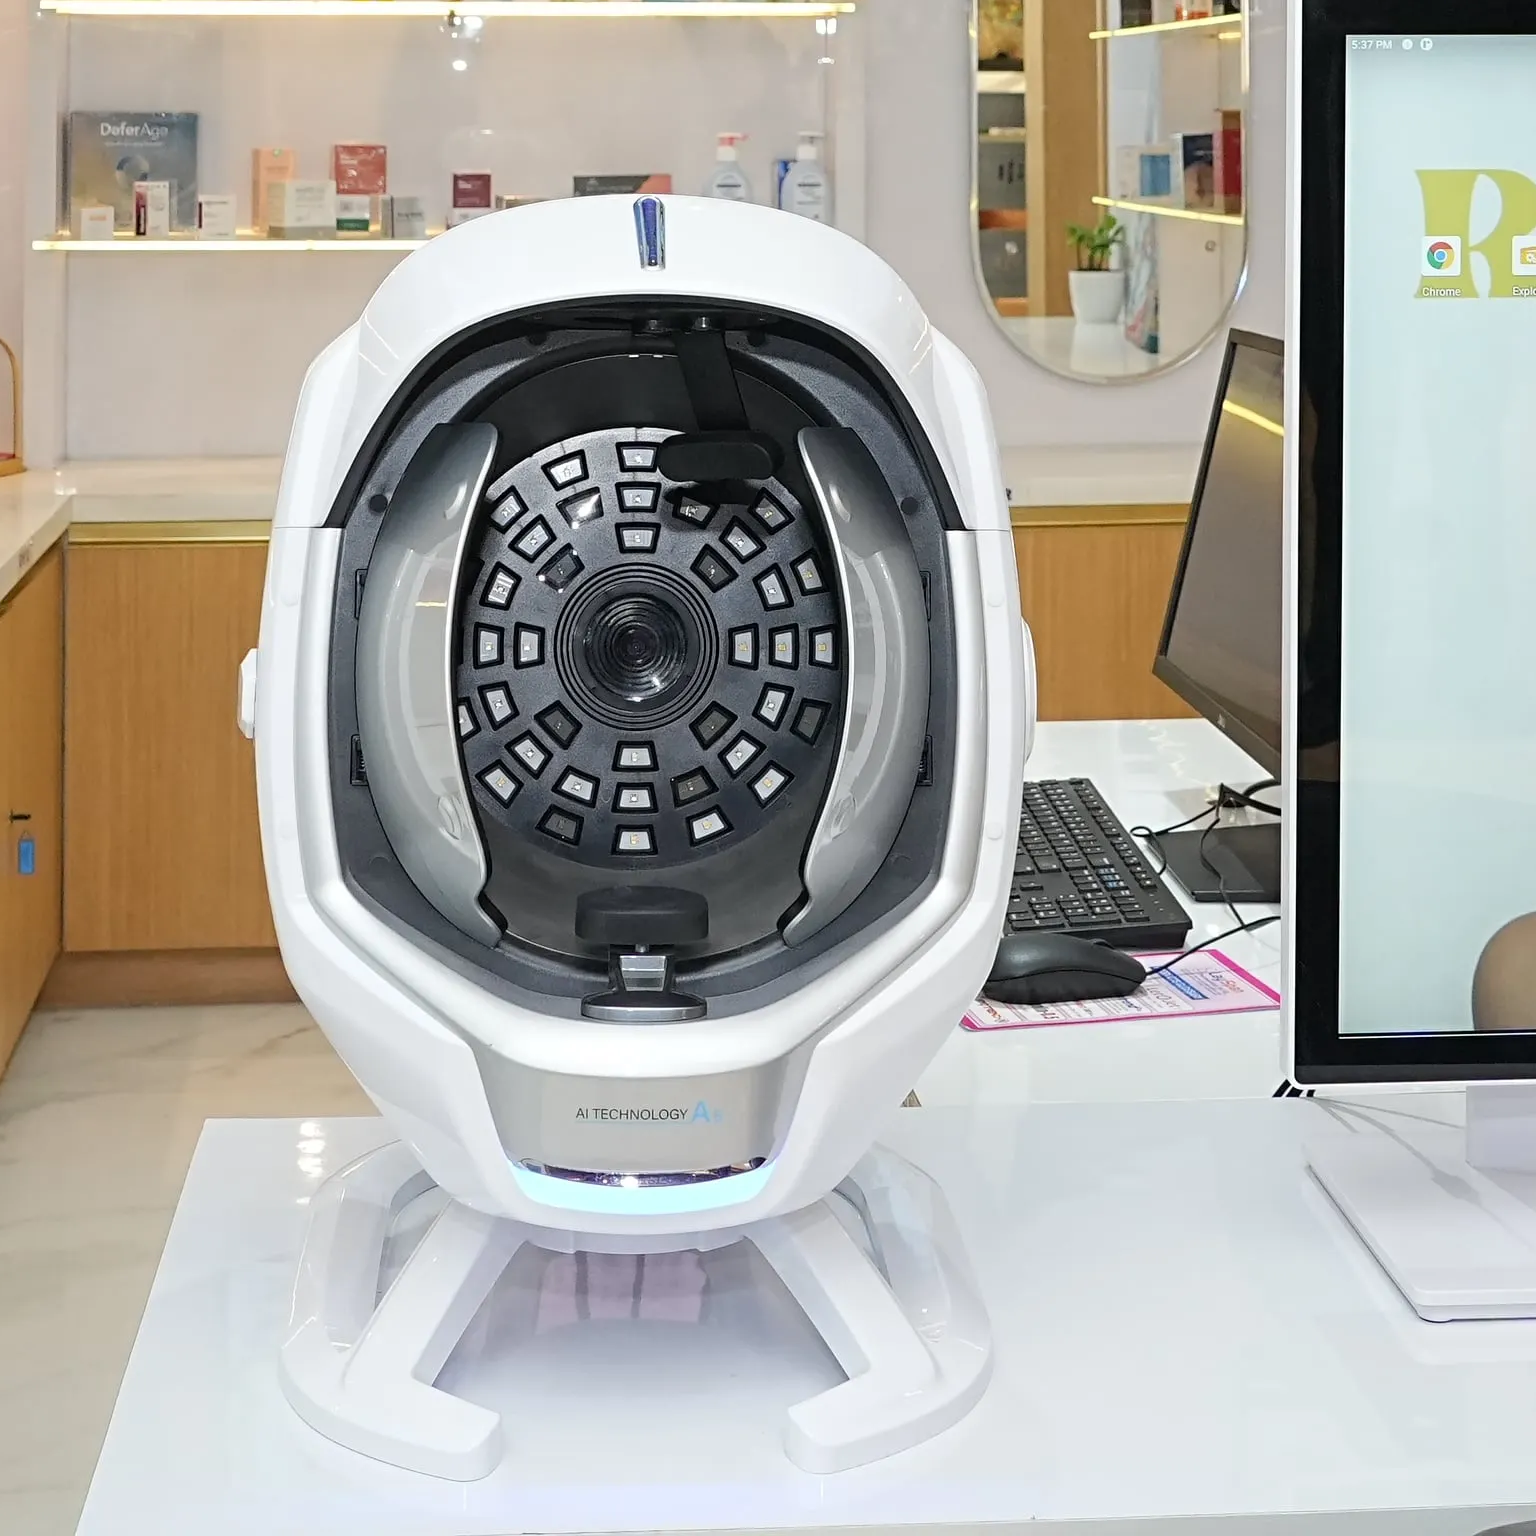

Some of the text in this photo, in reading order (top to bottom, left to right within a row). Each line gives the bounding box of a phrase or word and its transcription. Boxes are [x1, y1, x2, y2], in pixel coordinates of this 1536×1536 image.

[1352, 40, 1392, 49] 5:37 PM
[1422, 286, 1461, 297] Chrome
[576, 1108, 588, 1119] AI
[593, 1108, 688, 1121] TECHNOLOGY
